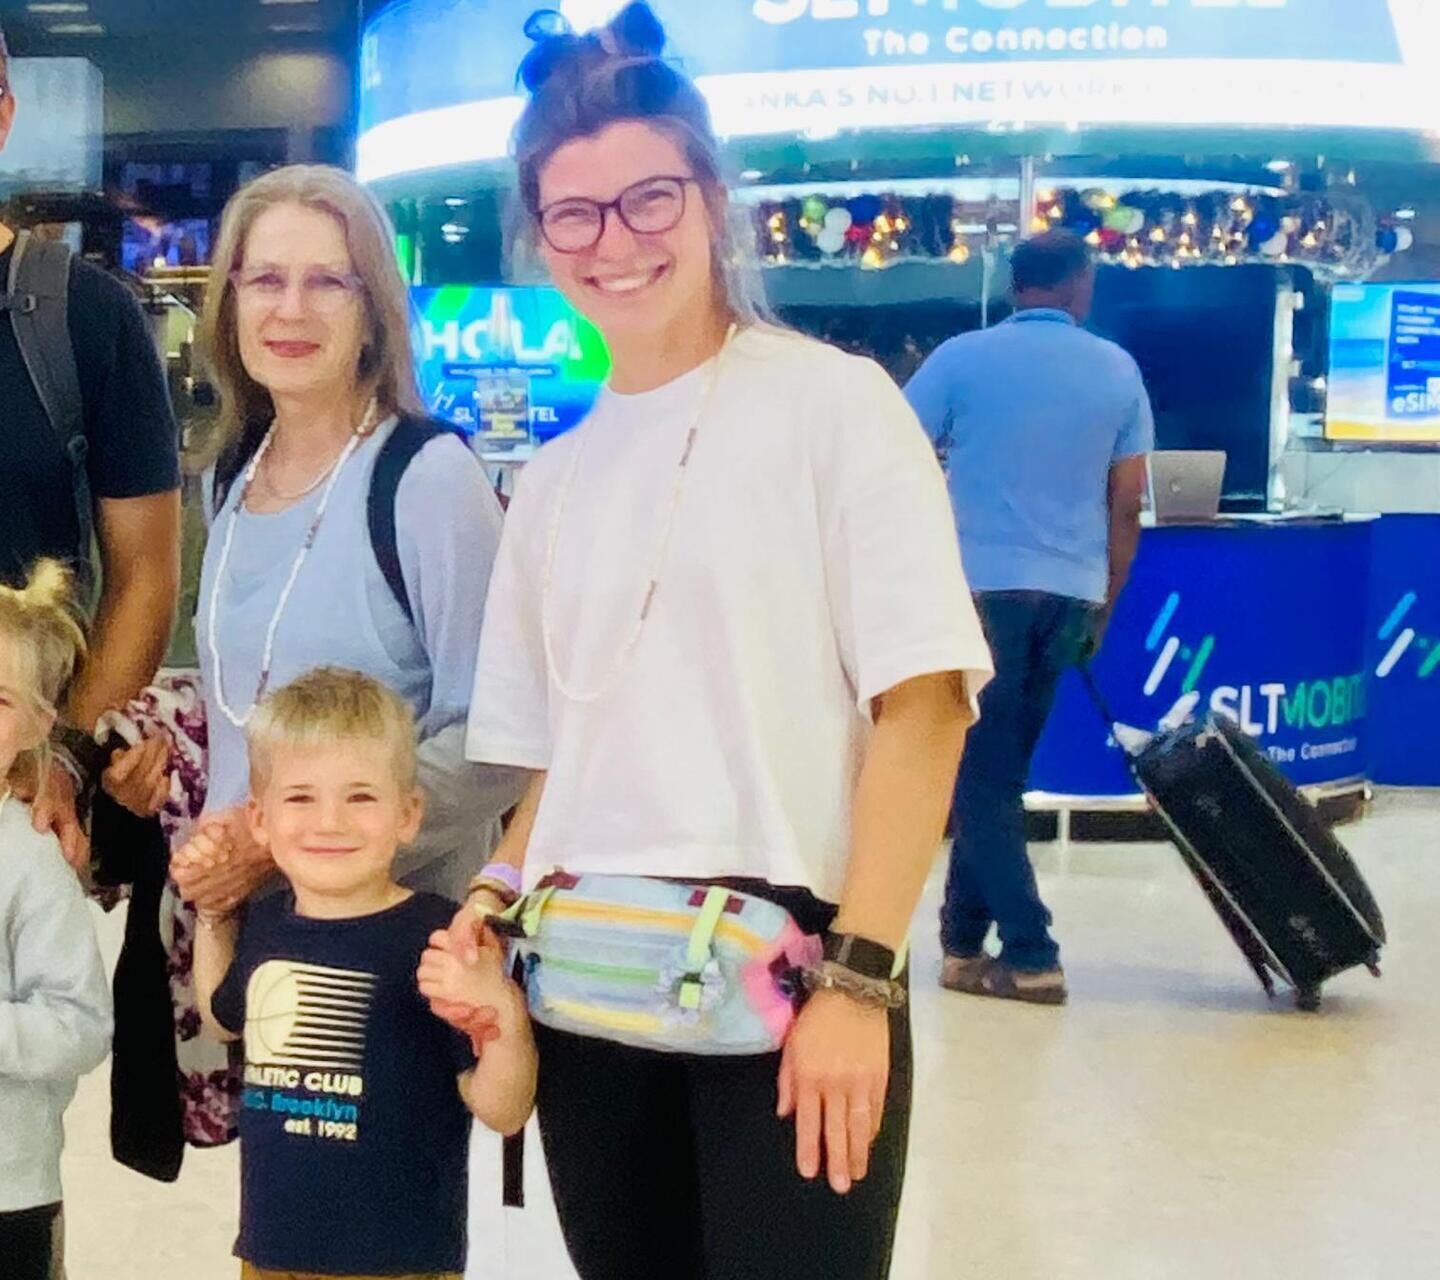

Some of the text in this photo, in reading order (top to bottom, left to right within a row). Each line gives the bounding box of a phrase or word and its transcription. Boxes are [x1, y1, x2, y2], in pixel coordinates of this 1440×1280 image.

[863, 23, 1168, 56] The Connection
[304, 1072, 363, 1096] CLUB
[318, 1120, 358, 1141] 1992
